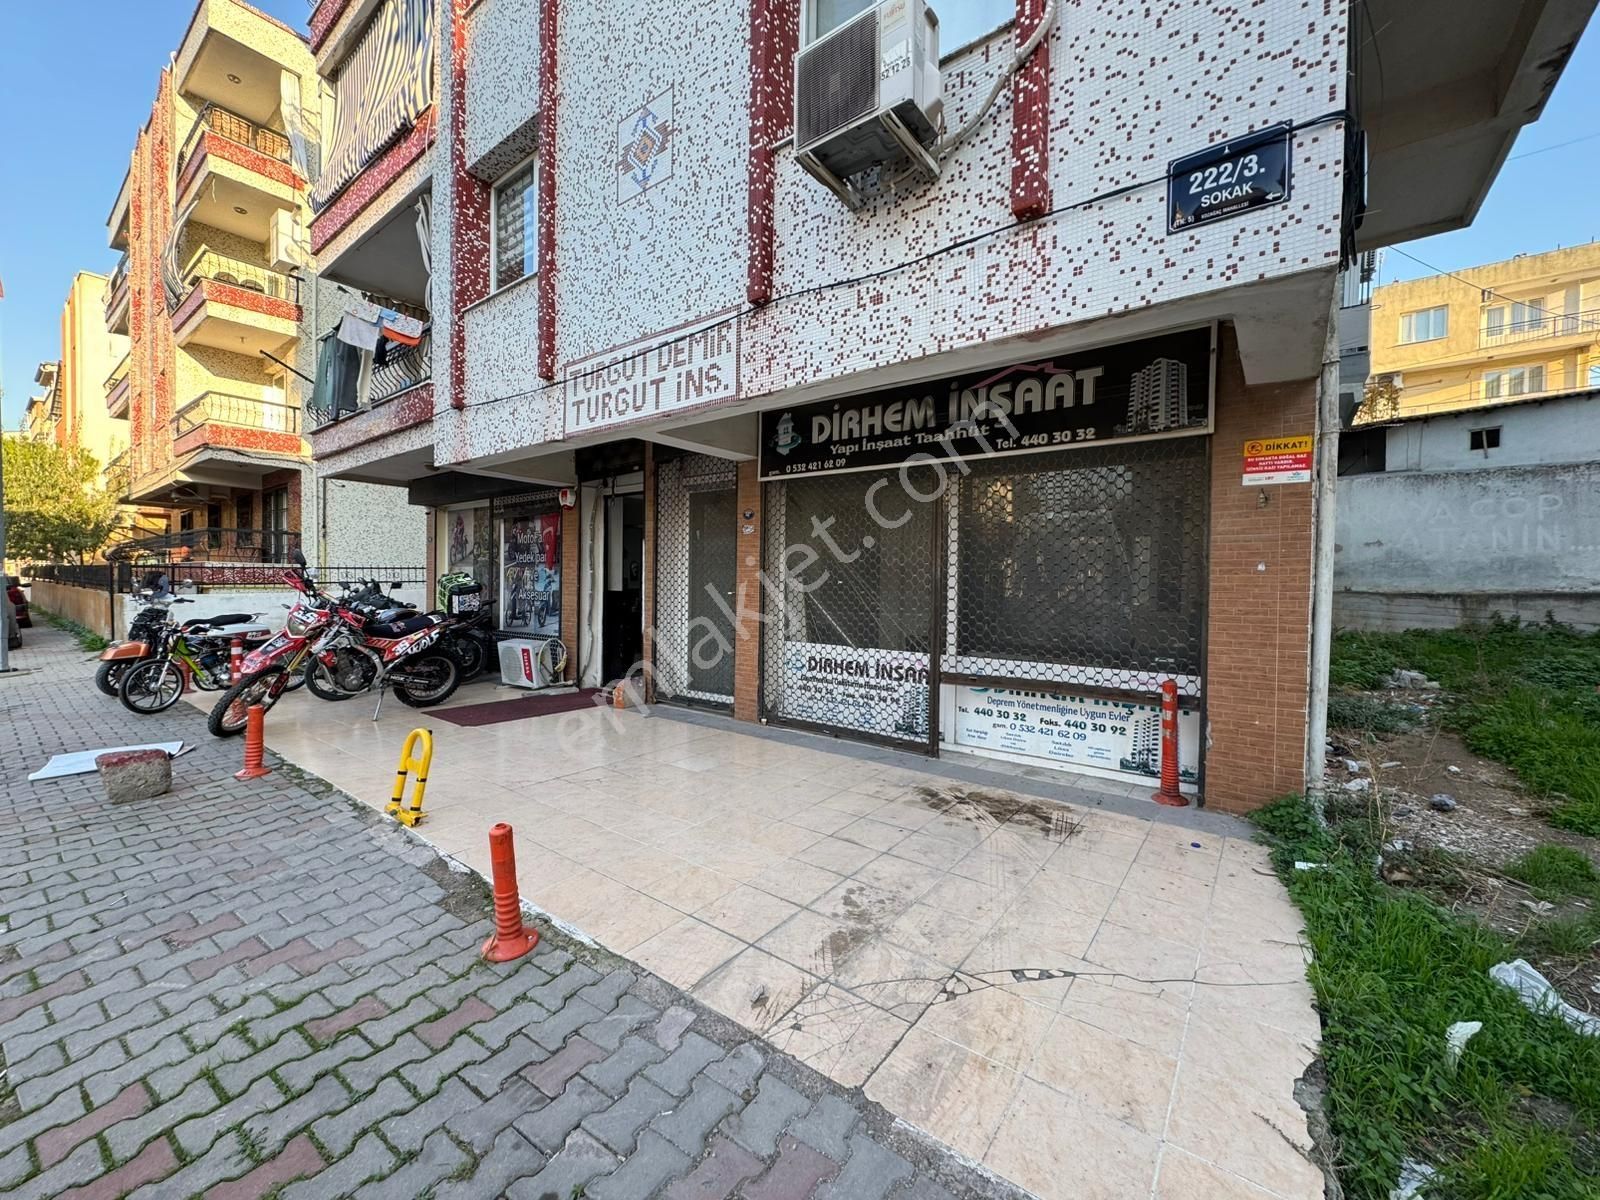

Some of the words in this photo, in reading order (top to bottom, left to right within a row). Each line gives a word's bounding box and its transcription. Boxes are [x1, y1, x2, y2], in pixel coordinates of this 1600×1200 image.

[1189, 154, 1266, 195] 222/3.
[1200, 181, 1254, 208] SOKAK
[569, 345, 653, 397] TURGUT
[572, 376, 666, 426] TURGUT
[811, 395, 936, 445] DİRHEM
[830, 444, 859, 456] Yapı
[862, 437, 911, 452] İnşaat
[914, 424, 990, 445] Taahhüt
[996, 438, 1017, 450] Tel.
[1020, 432, 1049, 447] 440
[1052, 429, 1072, 443] 30
[1075, 427, 1097, 441] 32
[1265, 440, 1308, 451] DİKKAT!
[785, 465, 791, 473] 0
[792, 464, 806, 472] 532
[808, 462, 822, 471] 421
[824, 460, 834, 469] 62
[835, 458, 846, 468] 09
[515, 552, 534, 564] Yedek
[518, 590, 550, 601] Aksesuar
[974, 707, 993, 718] 440
[996, 710, 1009, 719] 30
[1012, 712, 1027, 722] 32
[1064, 719, 1087, 731] 440
[1090, 722, 1107, 733] 30
[1110, 725, 1127, 736] 92
[987, 696, 1016, 709] Deprem
[1017, 700, 1078, 717] Yönetmenliğine
[1079, 707, 1107, 721] Uygun
[1108, 710, 1131, 723] Evler
[1009, 723, 1016, 731] 0
[1018, 724, 1036, 733] 532
[1038, 726, 1054, 736] 421
[1057, 728, 1070, 738] 62
[1072, 731, 1087, 741] 09
